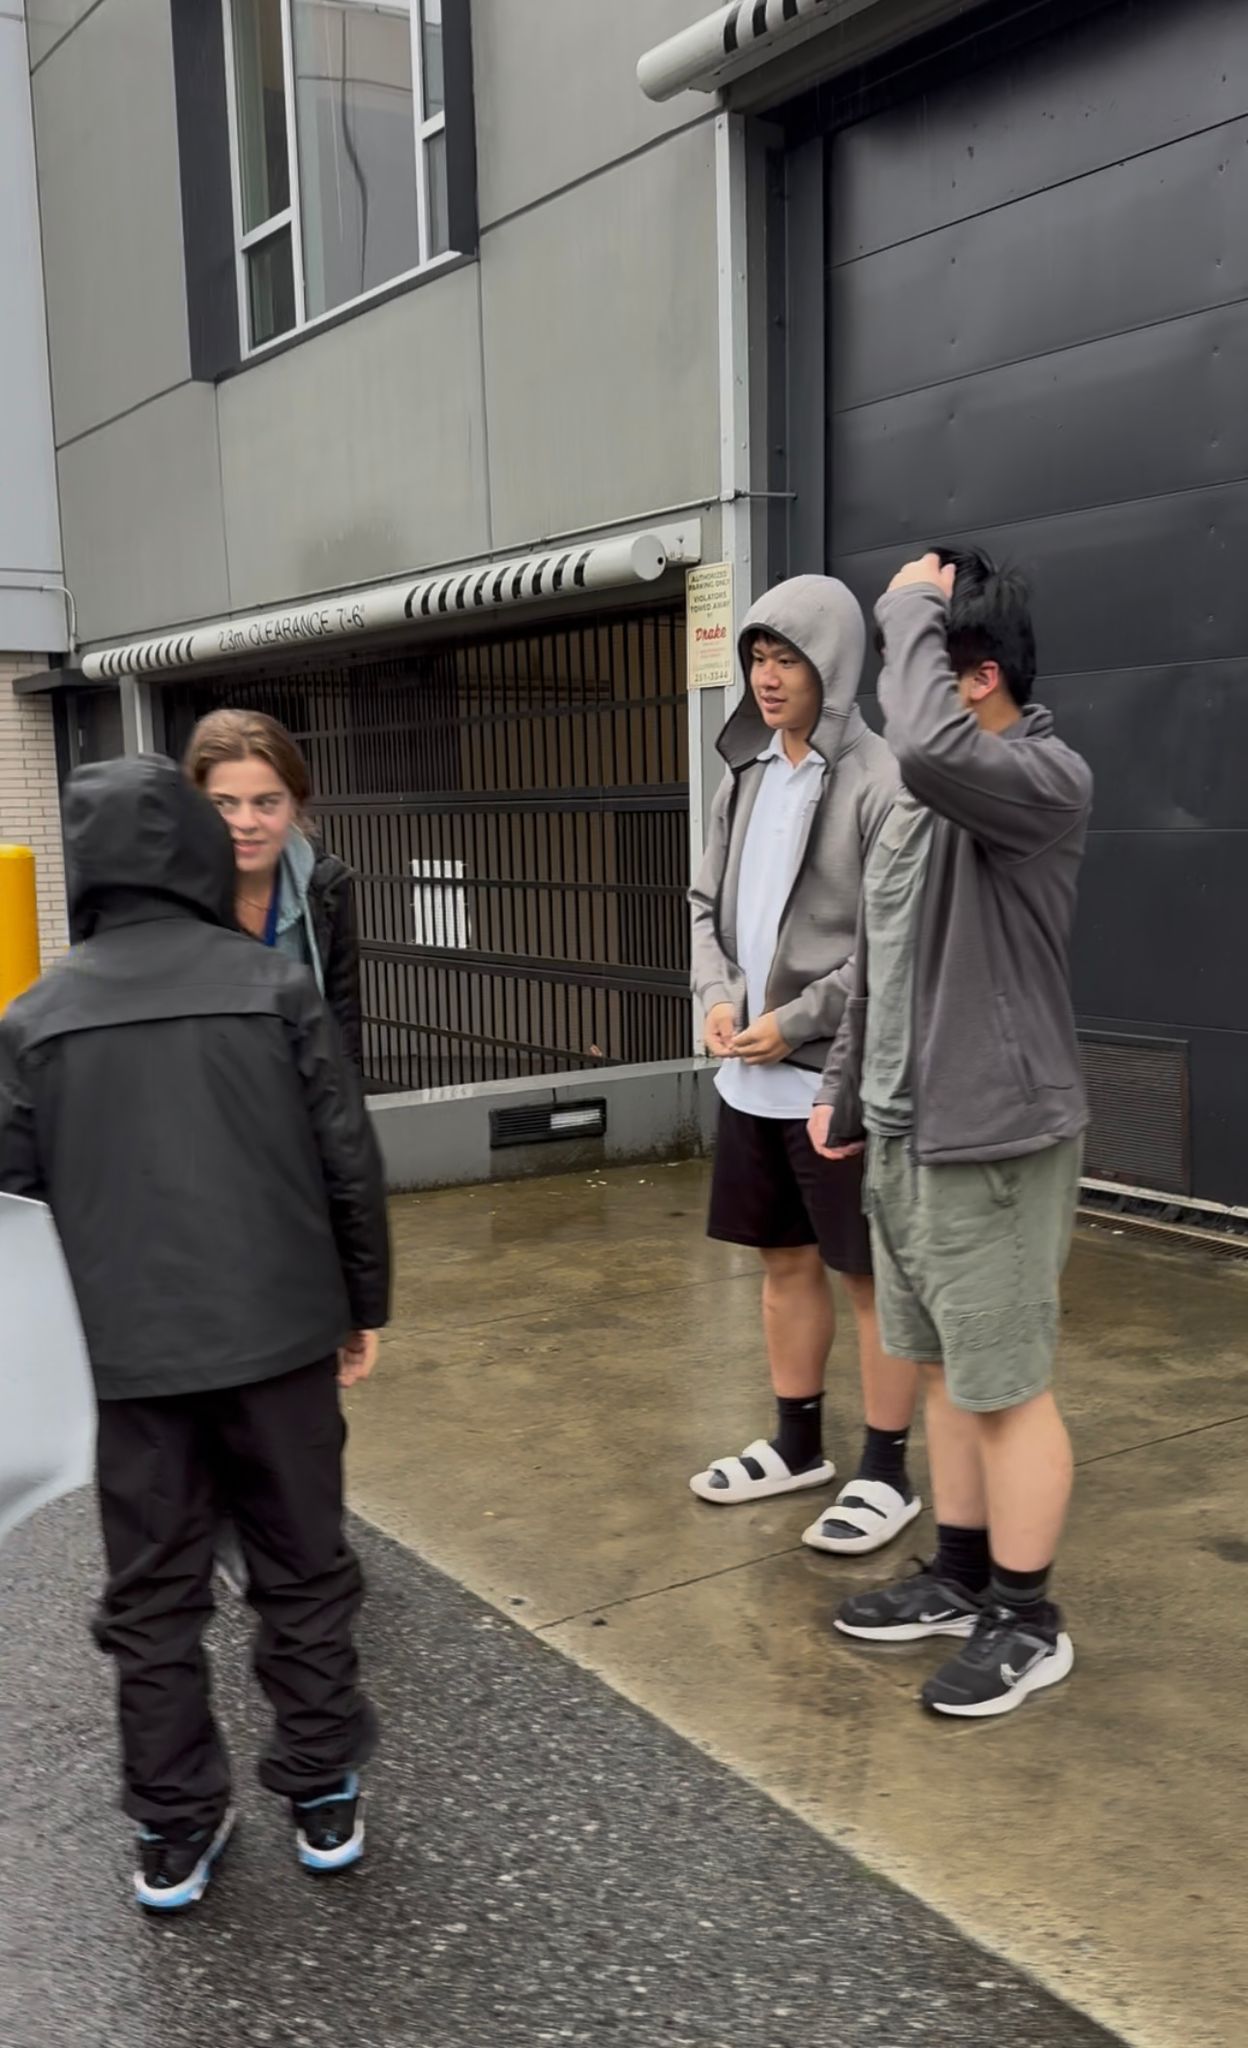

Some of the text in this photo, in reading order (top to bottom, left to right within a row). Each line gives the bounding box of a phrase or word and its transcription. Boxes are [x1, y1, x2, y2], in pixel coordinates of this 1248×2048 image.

[691, 570, 727, 582] AUTHORIZED
[688, 578, 730, 591] PARKING ONLY
[694, 591, 727, 603] VIOLATORS
[691, 600, 730, 613] TOWED AWAY
[249, 610, 333, 647] CLEARANCE
[695, 623, 727, 642] Drake
